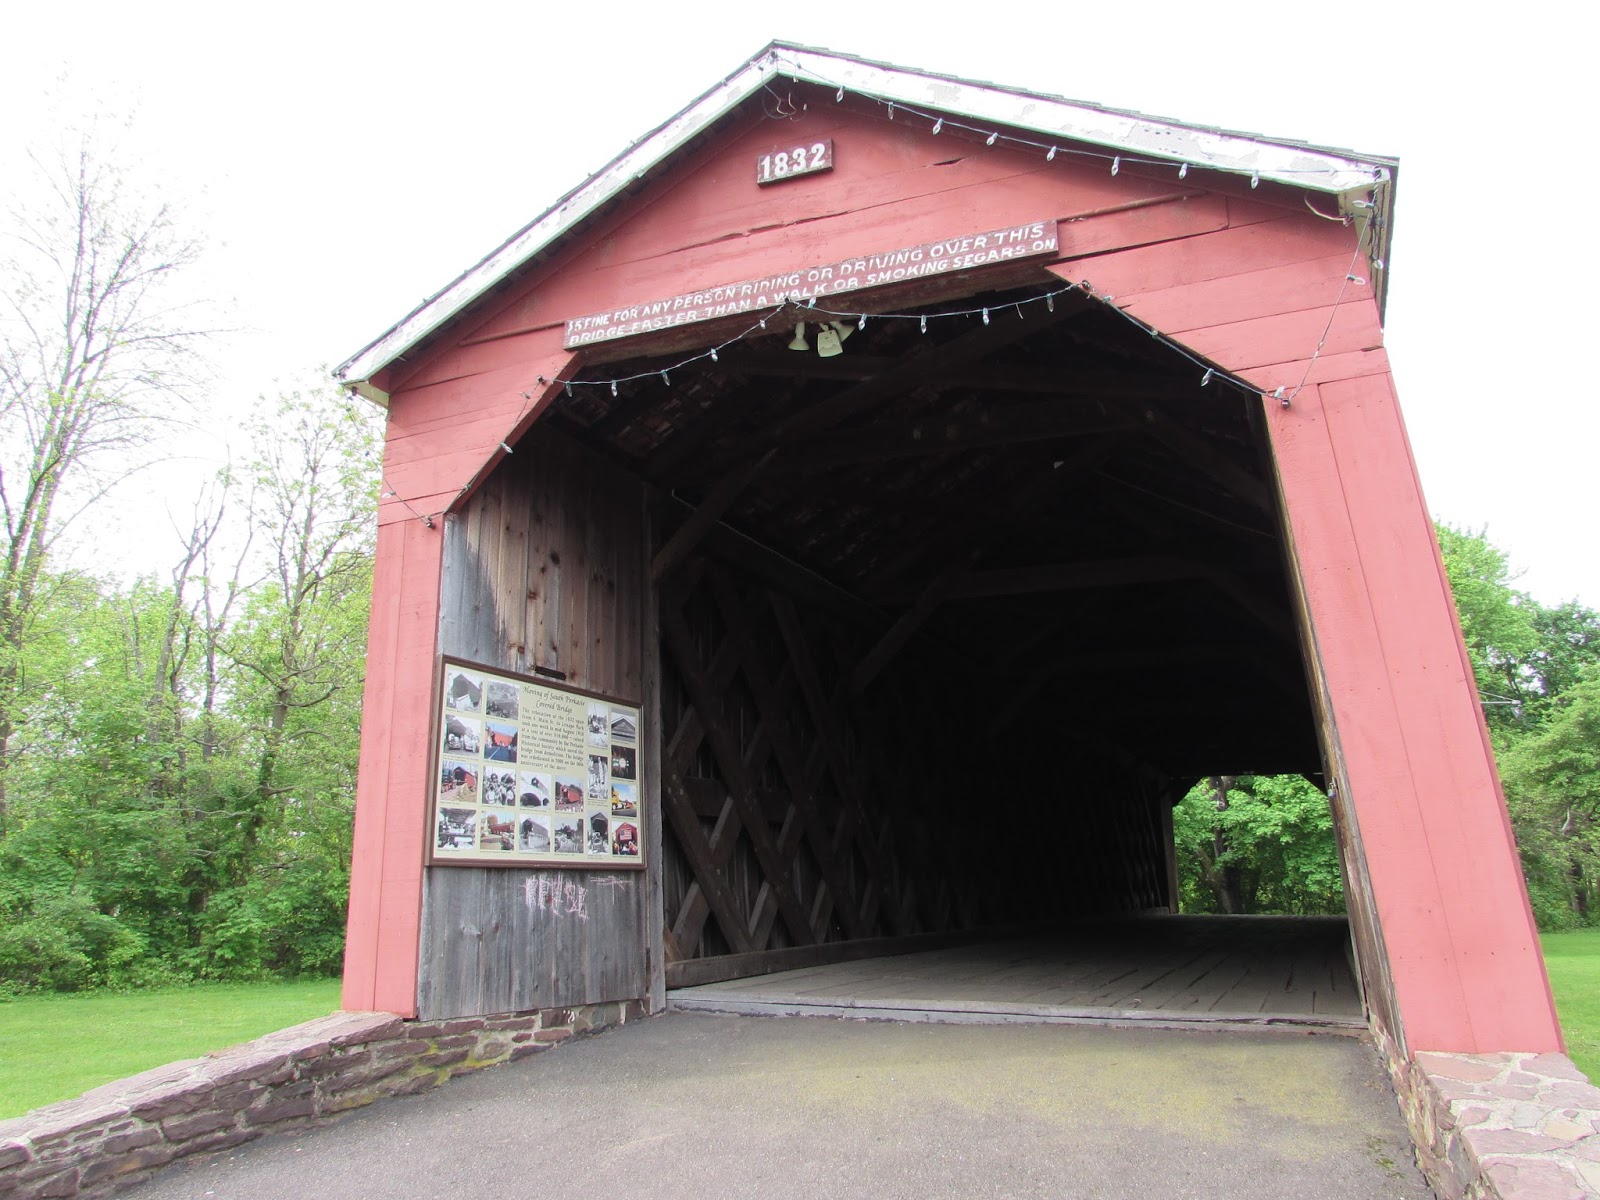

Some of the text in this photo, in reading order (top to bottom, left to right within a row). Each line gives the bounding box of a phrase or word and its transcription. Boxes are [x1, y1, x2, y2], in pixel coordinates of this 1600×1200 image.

[761, 143, 825, 179] 1832
[569, 238, 1056, 345] BRIDGE FASTER THAN A WALK OR SMOKING SEGARS ON
[585, 314, 611, 329] FINE
[614, 309, 638, 322] FOR
[642, 302, 670, 317] ANY
[674, 286, 736, 310] PERSON
[741, 275, 800, 296] RIDING
[808, 267, 832, 282] OR
[840, 250, 923, 275] DRIVING
[930, 237, 987, 258] OVER
[995, 224, 1045, 245] THIS
[523, 686, 585, 706] Moving of South Perkasie
[536, 700, 572, 715] Covered Bridge
